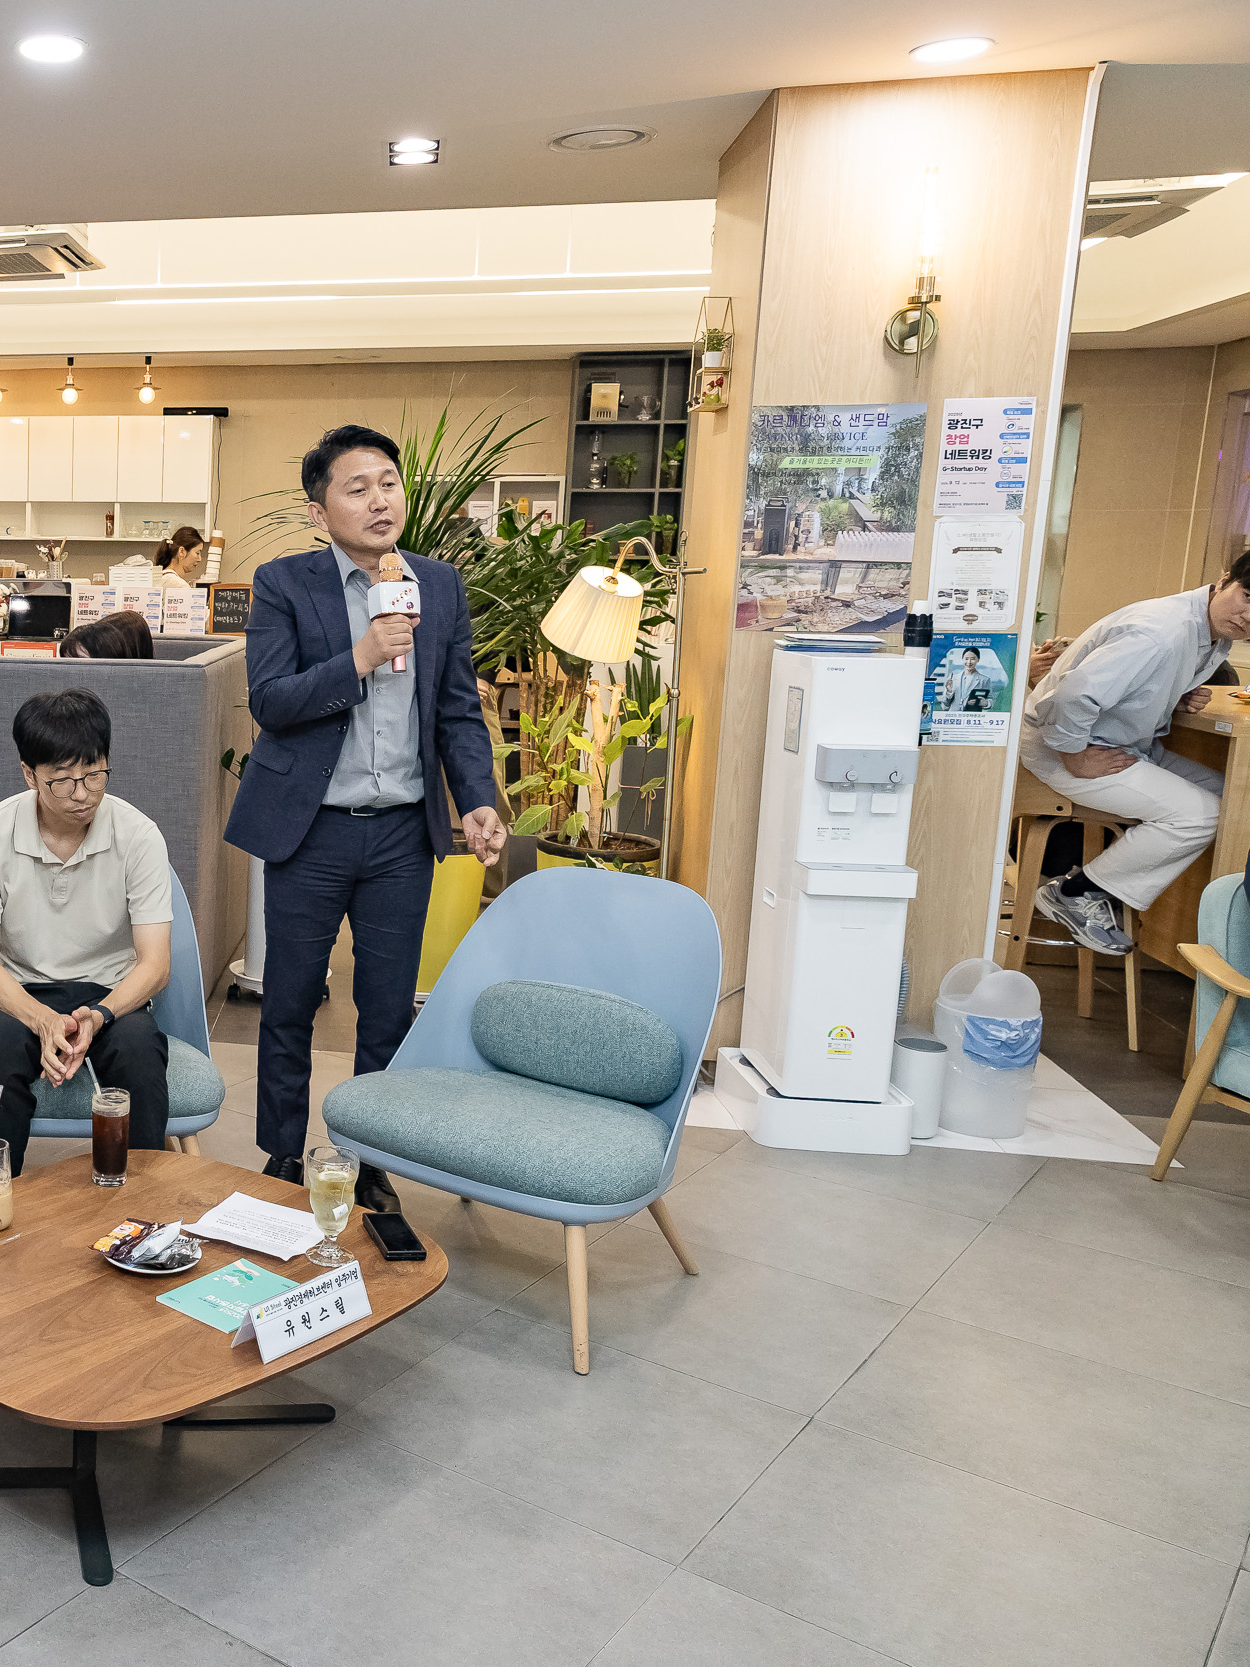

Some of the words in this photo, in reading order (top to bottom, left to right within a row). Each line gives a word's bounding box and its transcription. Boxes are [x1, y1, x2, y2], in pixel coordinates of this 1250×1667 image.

[758, 412, 826, 428] 카르페디엠
[832, 414, 842, 428] &
[849, 412, 890, 428] 샌드맘
[947, 418, 984, 430] 광진구
[820, 432, 868, 441] SERVICE
[946, 434, 970, 446] 창업
[944, 448, 992, 460] 네트워킹
[335, 1268, 359, 1287] 입주기업
